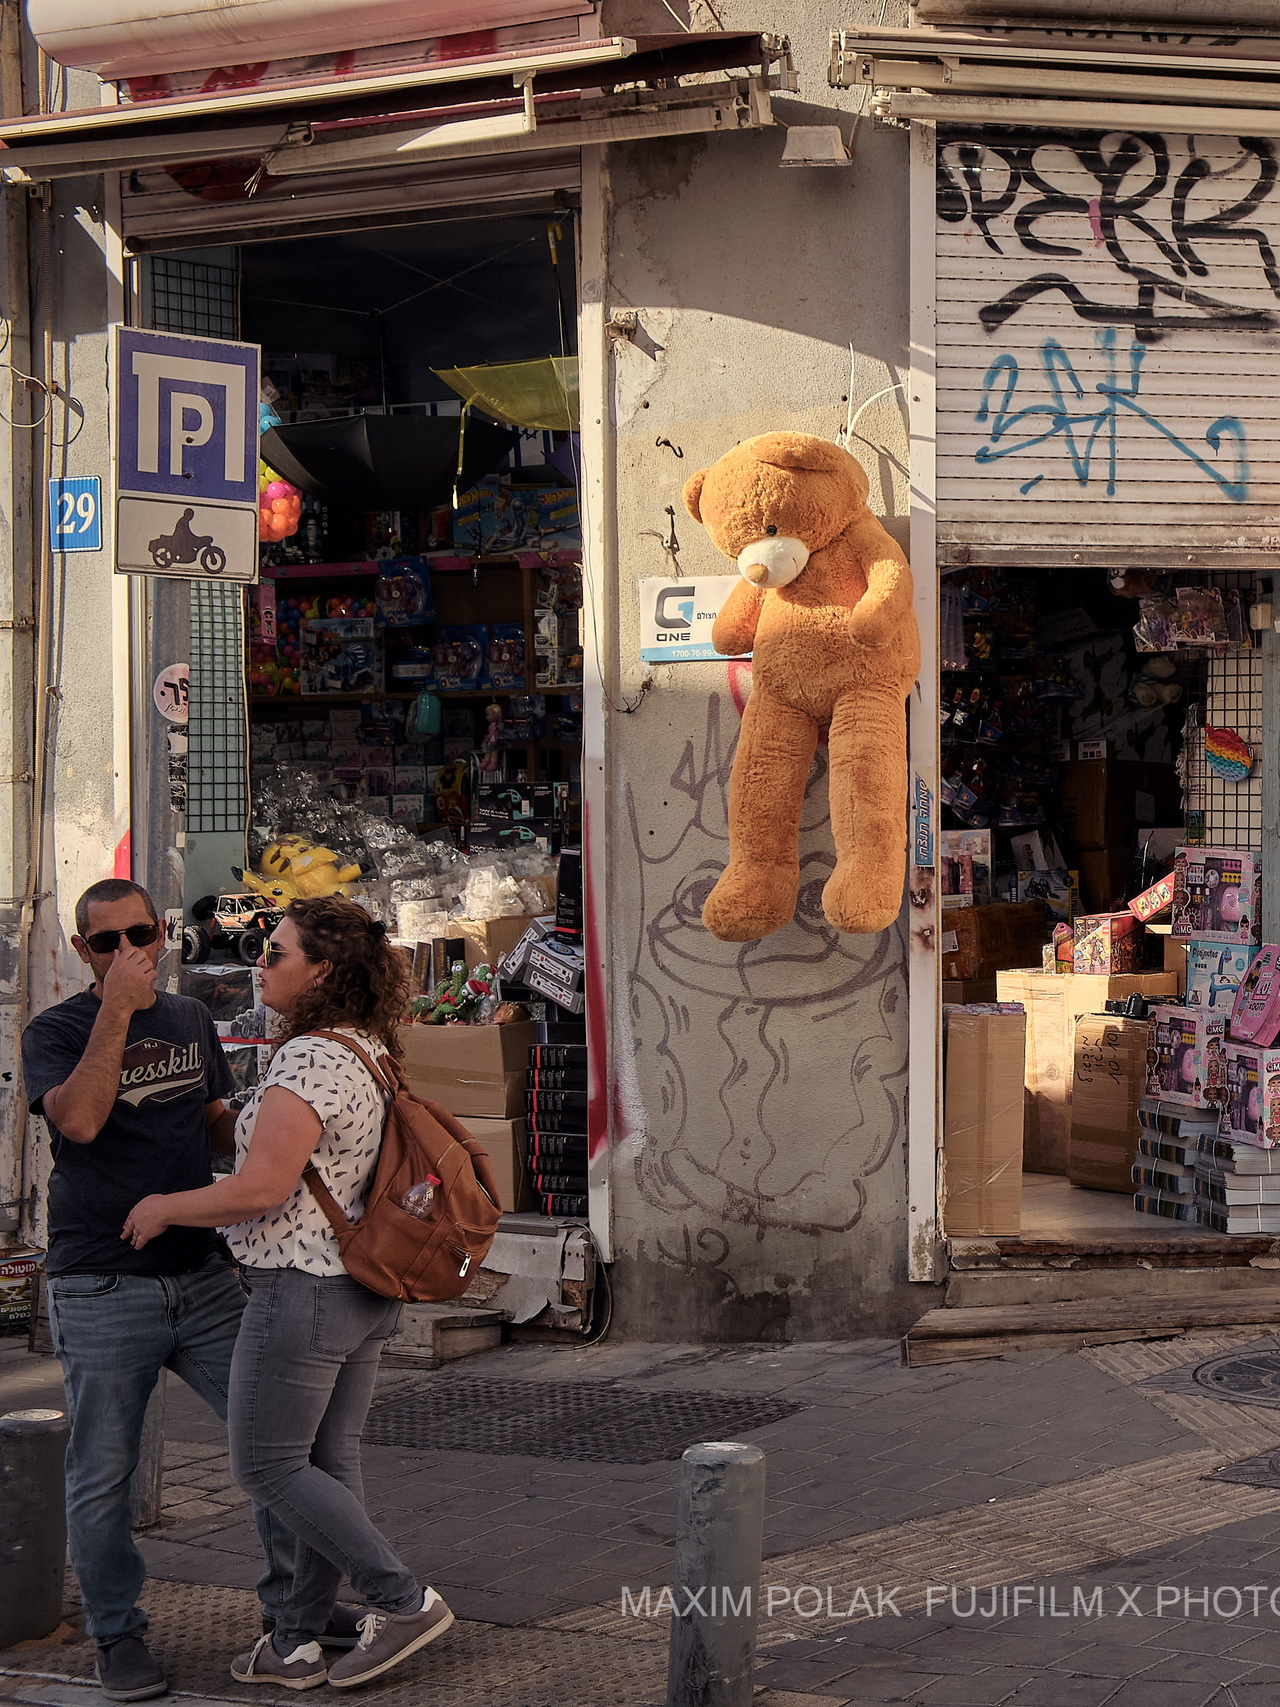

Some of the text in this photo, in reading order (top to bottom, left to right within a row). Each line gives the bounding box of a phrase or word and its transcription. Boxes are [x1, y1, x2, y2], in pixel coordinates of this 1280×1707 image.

[170, 391, 214, 476] P
[55, 492, 96, 535] 29
[656, 632, 691, 642] ONE
[672, 649, 722, 658] 1700-70-99-
[120, 1042, 202, 1085] resskill
[1, 1263, 36, 1275] מוטולה
